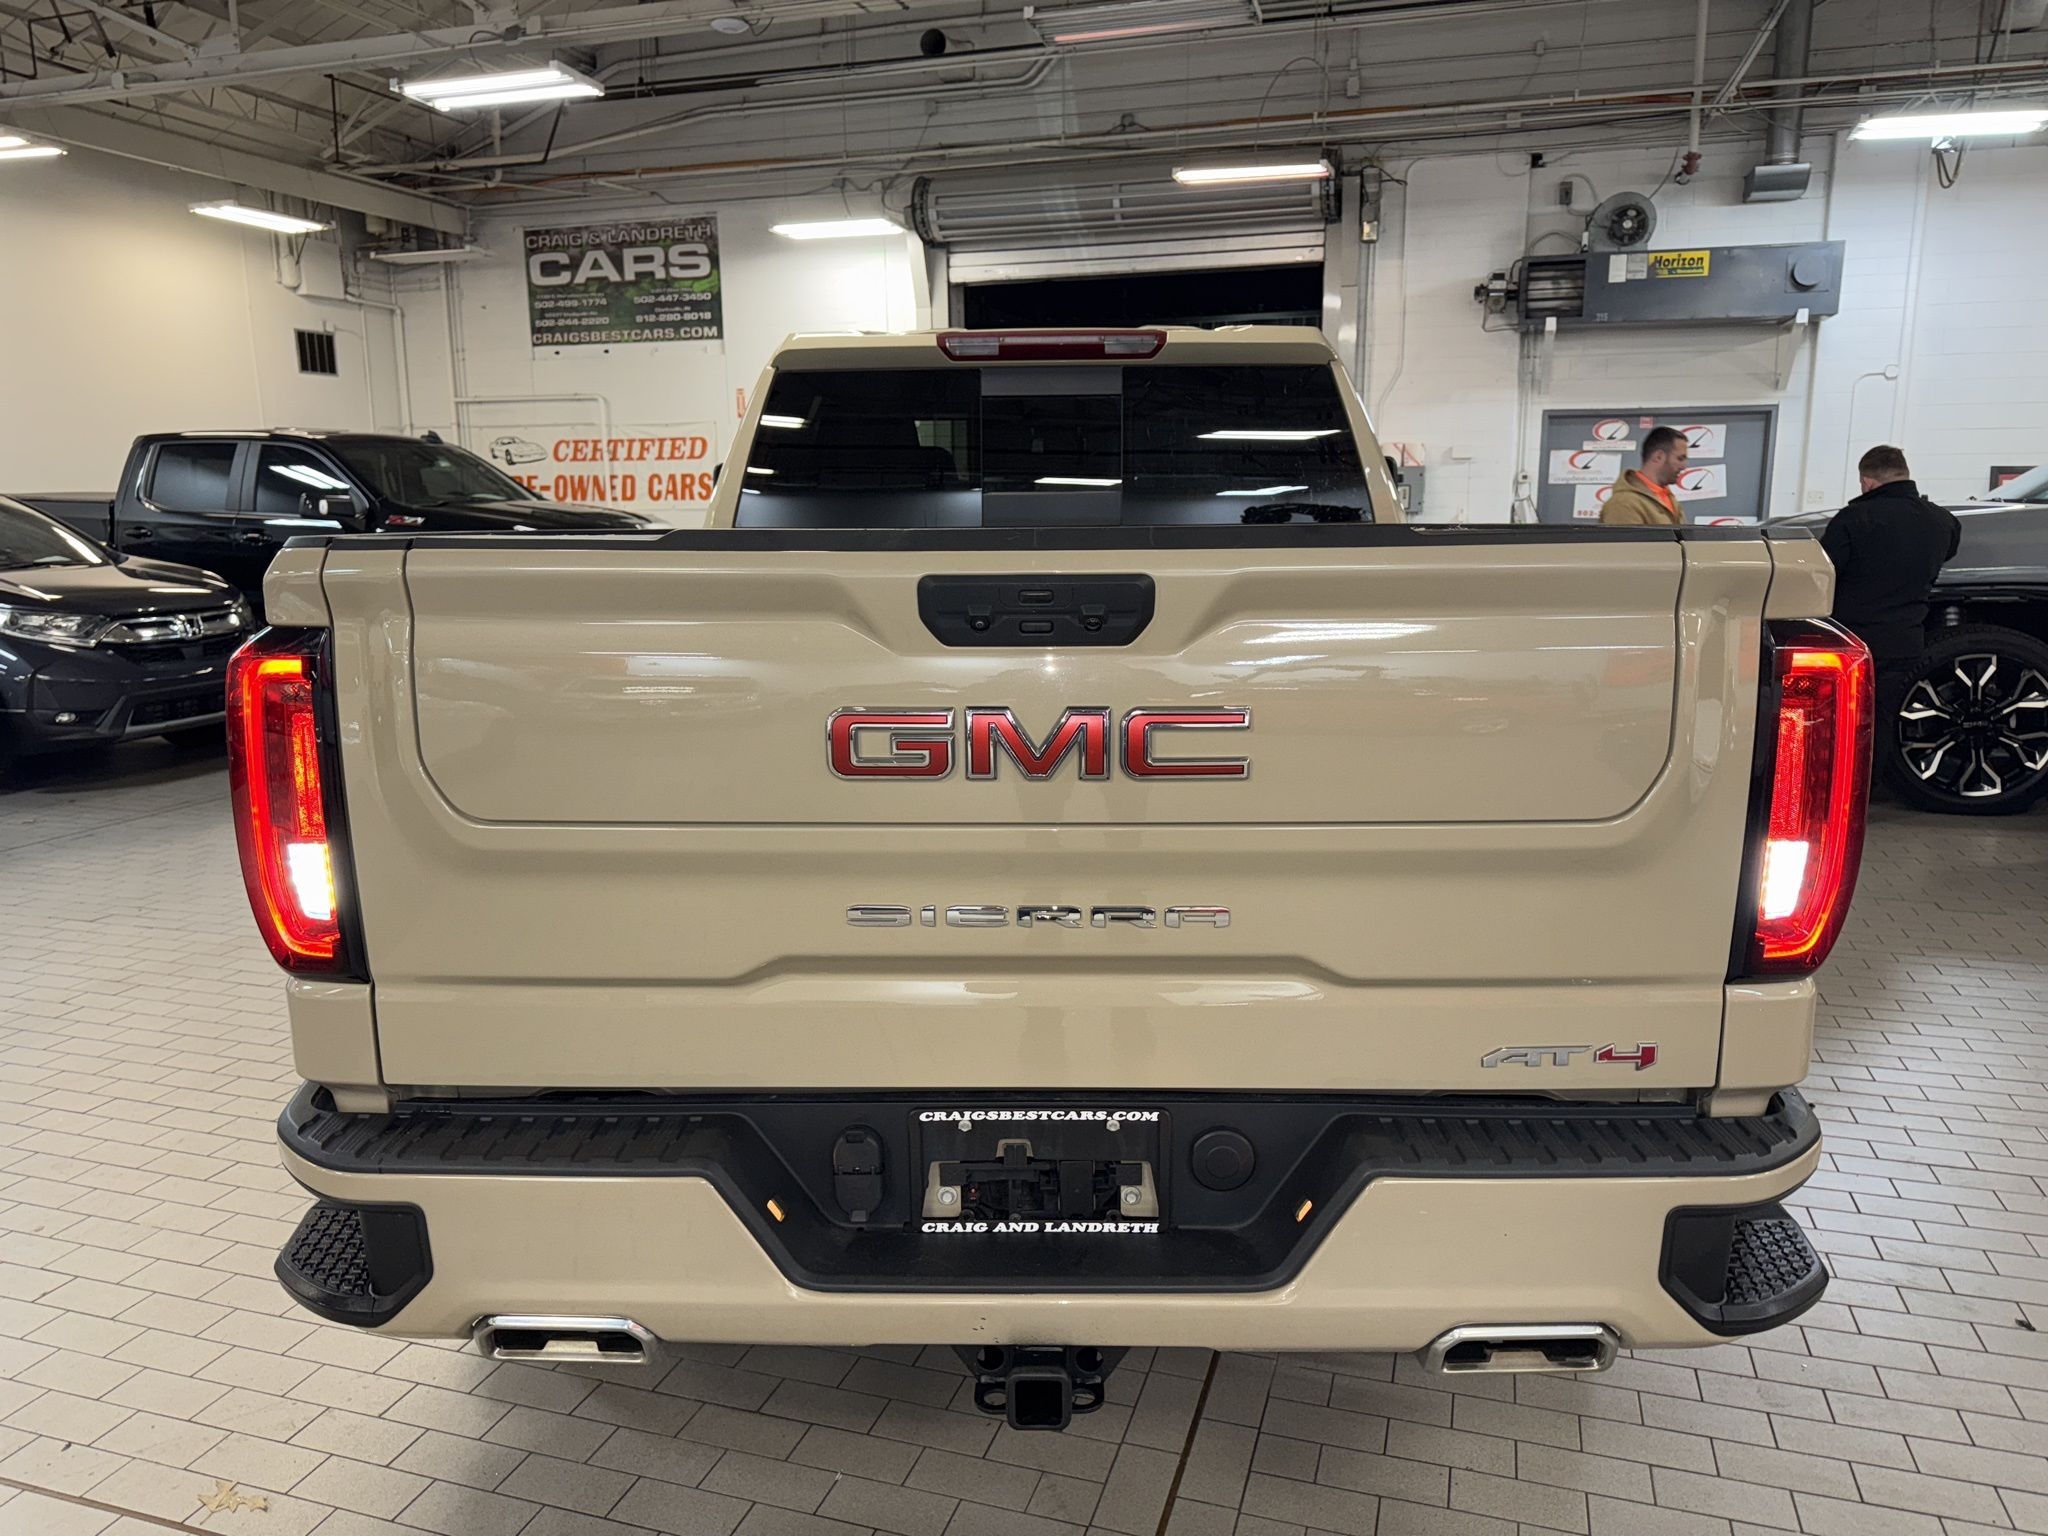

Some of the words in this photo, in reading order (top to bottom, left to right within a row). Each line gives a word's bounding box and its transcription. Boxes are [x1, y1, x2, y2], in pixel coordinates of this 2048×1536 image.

[526, 233, 582, 249] CRAIG
[588, 232, 601, 245] &
[607, 224, 711, 243] LANDRETH
[529, 243, 711, 286] CARS
[1654, 254, 1704, 267] Horizon
[533, 326, 718, 344] CRAIGSBESTCARS.COM
[553, 437, 708, 462] CERTIFIED
[648, 472, 713, 502] CARS
[826, 705, 1253, 782] GMC
[846, 904, 1231, 929] SIERRA
[1481, 1041, 1658, 1071] AT4
[919, 1111, 1159, 1122] CRAIGSBESTCARS.COM
[921, 1222, 988, 1234] CRAIG
[992, 1222, 1040, 1234] AND
[1044, 1222, 1159, 1234] LANDRETH
